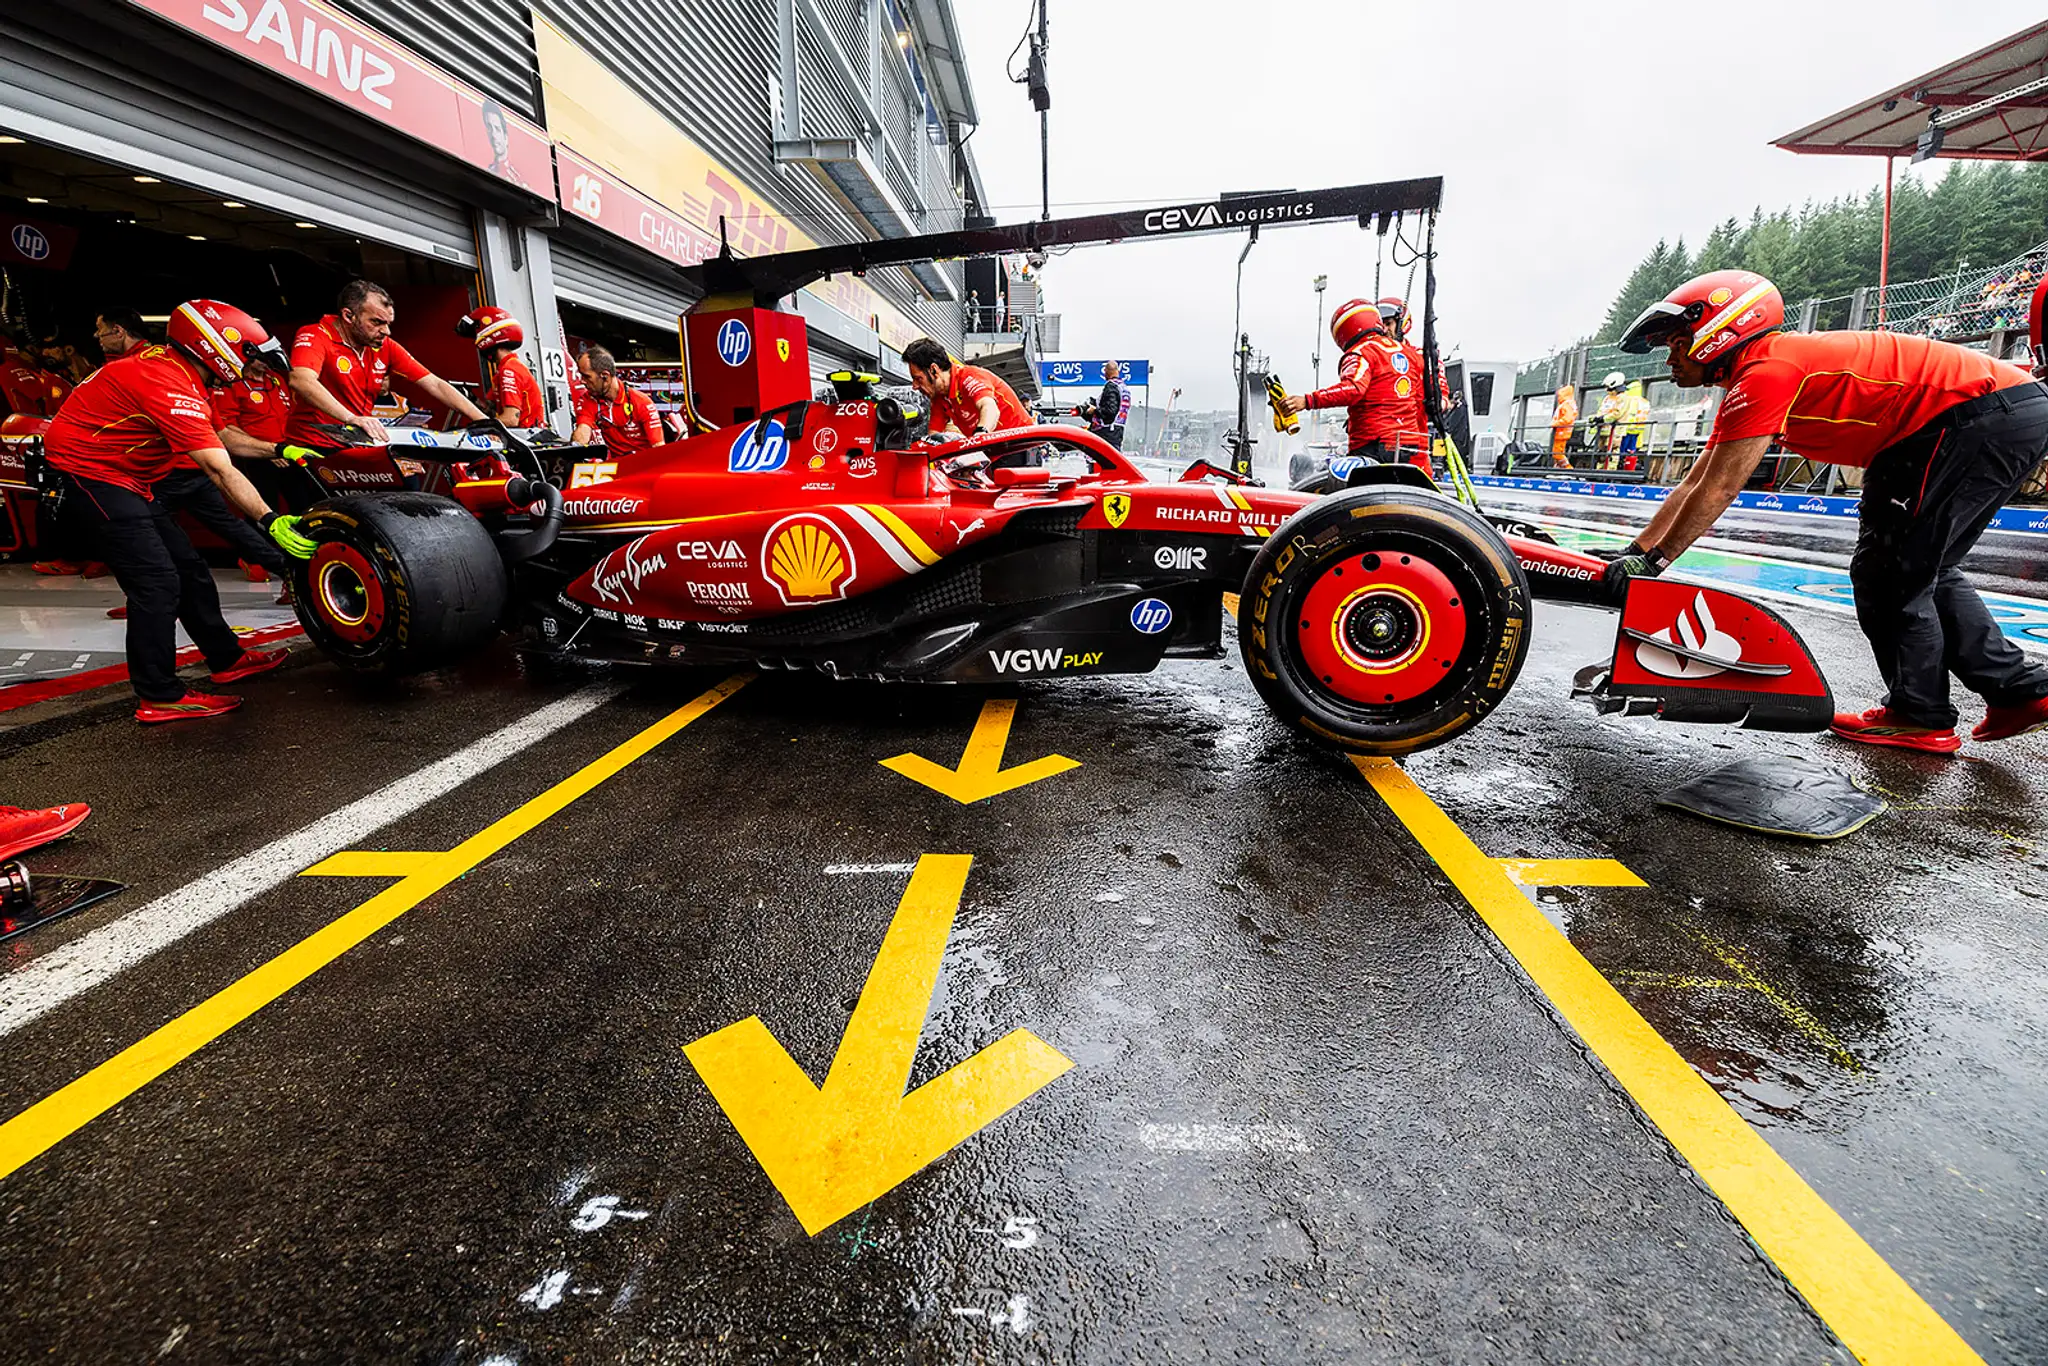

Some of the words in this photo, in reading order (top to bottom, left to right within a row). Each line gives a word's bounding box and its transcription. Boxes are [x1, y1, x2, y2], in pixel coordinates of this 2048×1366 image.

[203, 0, 396, 110] SAINZ
[572, 173, 602, 218] 16
[1226, 203, 1314, 223] LOGISTICS
[19, 226, 44, 259] hp
[723, 320, 746, 365] hp
[545, 352, 564, 379] 13
[1053, 362, 1083, 375] aws
[835, 402, 869, 416] ZCG
[849, 456, 876, 470] aws
[333, 469, 395, 484] V-Power
[563, 497, 644, 516] antander
[1155, 506, 1232, 523] RICHARD
[677, 540, 747, 560] CEVA
[707, 561, 749, 569] LOGISTICS
[1516, 555, 1597, 581] antander
[686, 580, 750, 600] PERONI
[1252, 544, 1296, 650] ZERO
[658, 618, 686, 631] SKF
[1136, 599, 1168, 633] hp
[989, 648, 1063, 673] VGW
[1063, 652, 1104, 668] PLAY
